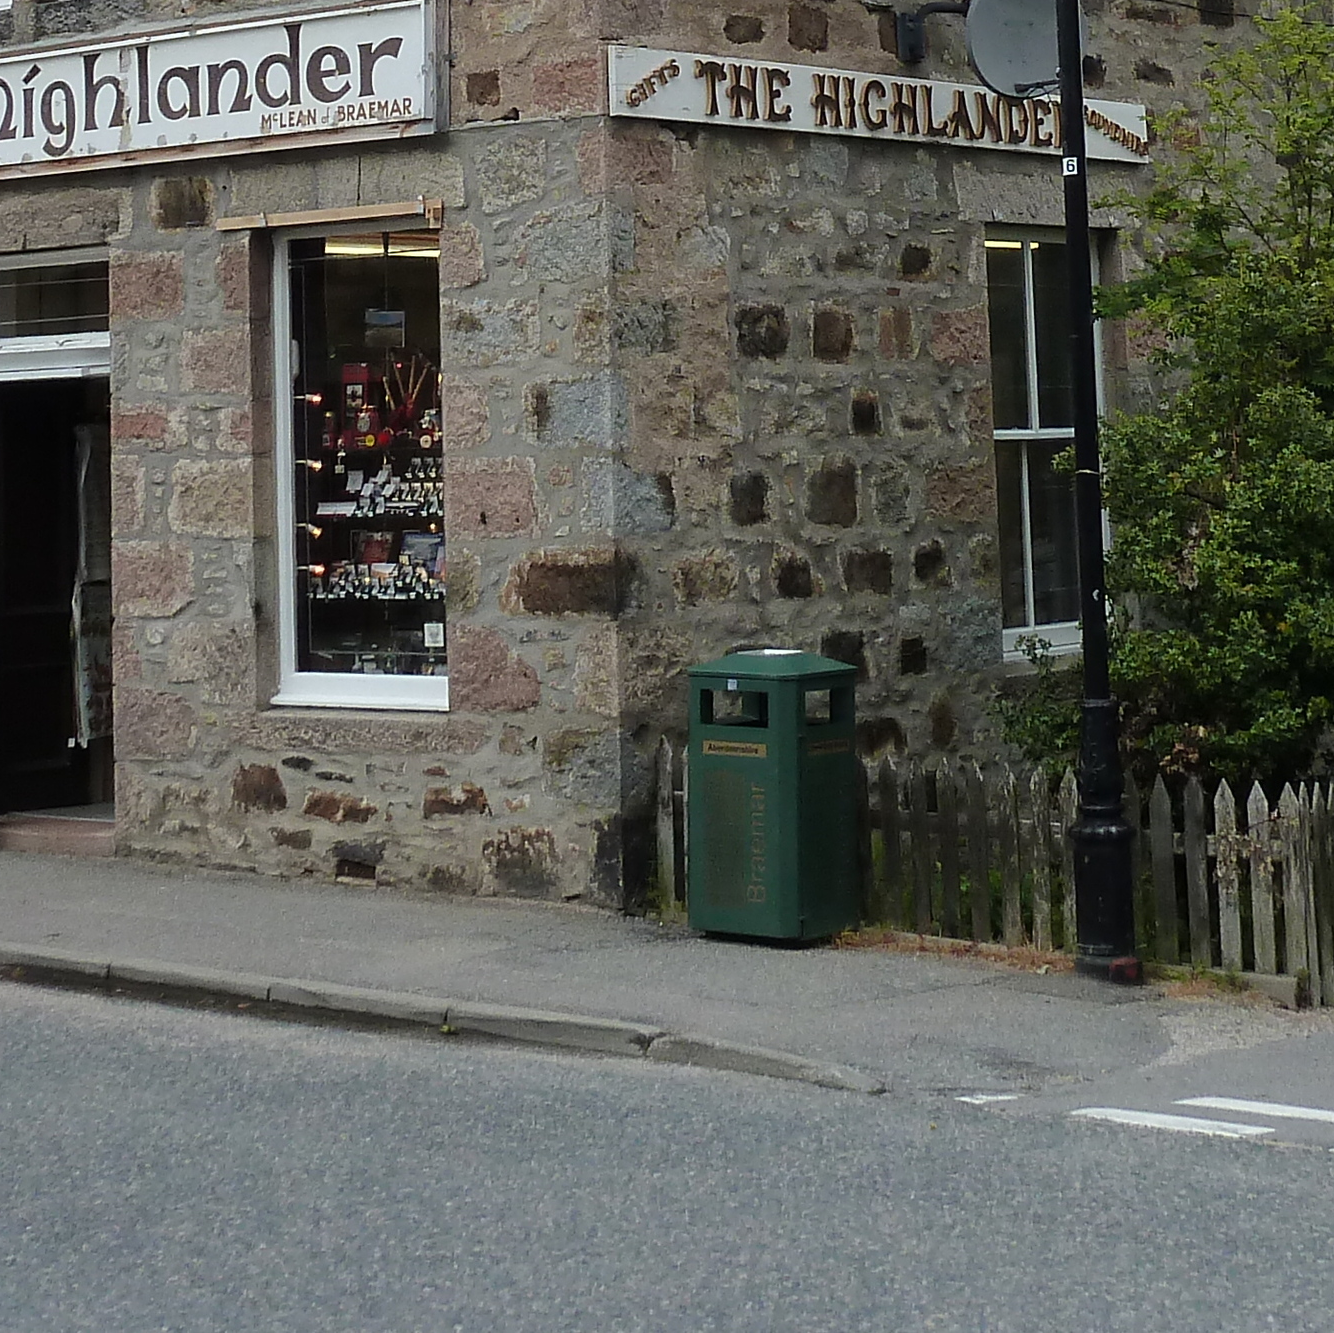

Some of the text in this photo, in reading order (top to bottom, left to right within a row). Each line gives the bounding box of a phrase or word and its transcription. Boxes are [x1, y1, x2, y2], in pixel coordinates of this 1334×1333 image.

[625, 59, 680, 107] GIFTS
[694, 59, 792, 122] THE
[261, 109, 316, 130] McLEAN
[338, 98, 412, 122] BRAEMAR
[1067, 159, 1075, 172] 6
[747, 783, 766, 903] Braemar
